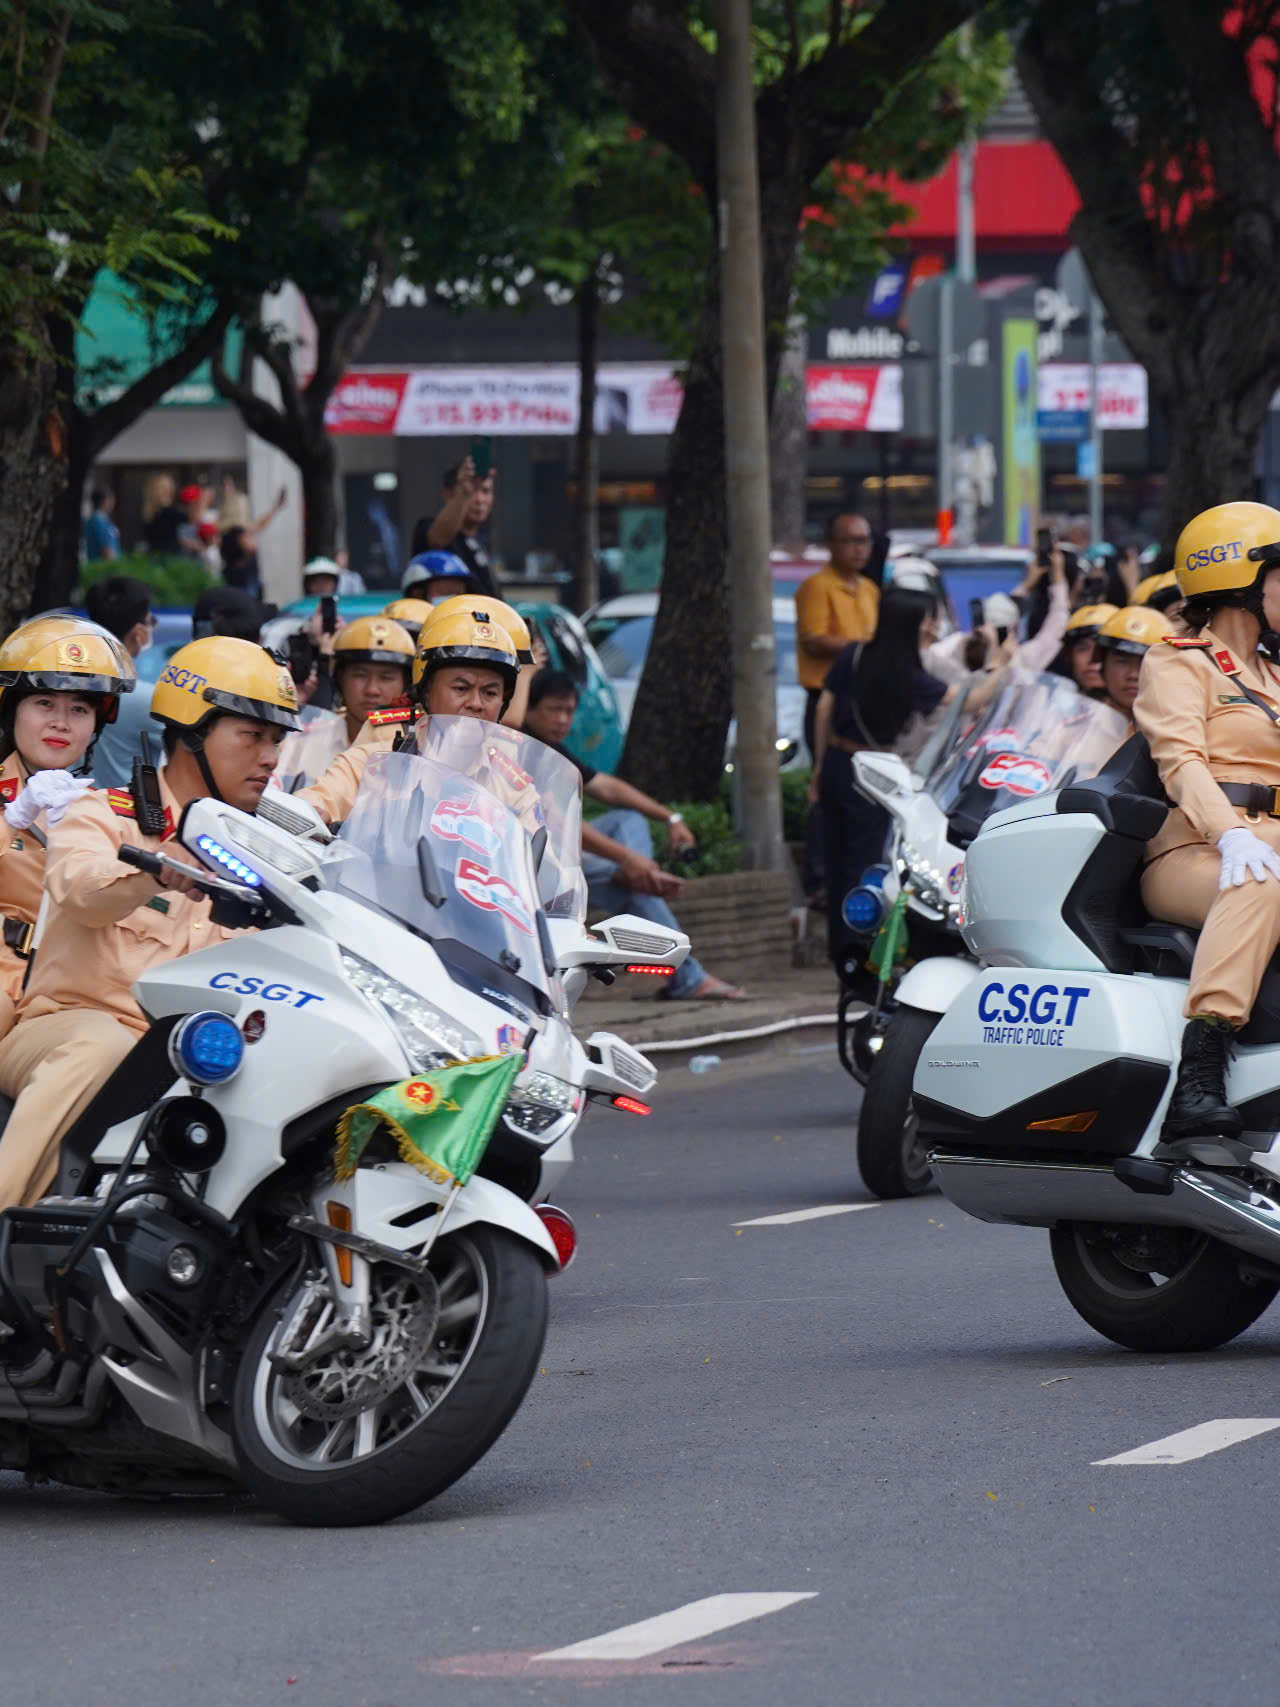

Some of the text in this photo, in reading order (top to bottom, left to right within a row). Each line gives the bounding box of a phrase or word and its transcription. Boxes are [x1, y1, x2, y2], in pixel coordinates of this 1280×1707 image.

[1186, 541, 1242, 571] CSGT
[160, 664, 208, 694] SGT
[978, 982, 1091, 1027] C.S.G.T
[983, 1027, 1065, 1047] TRAFFIC POLICE
